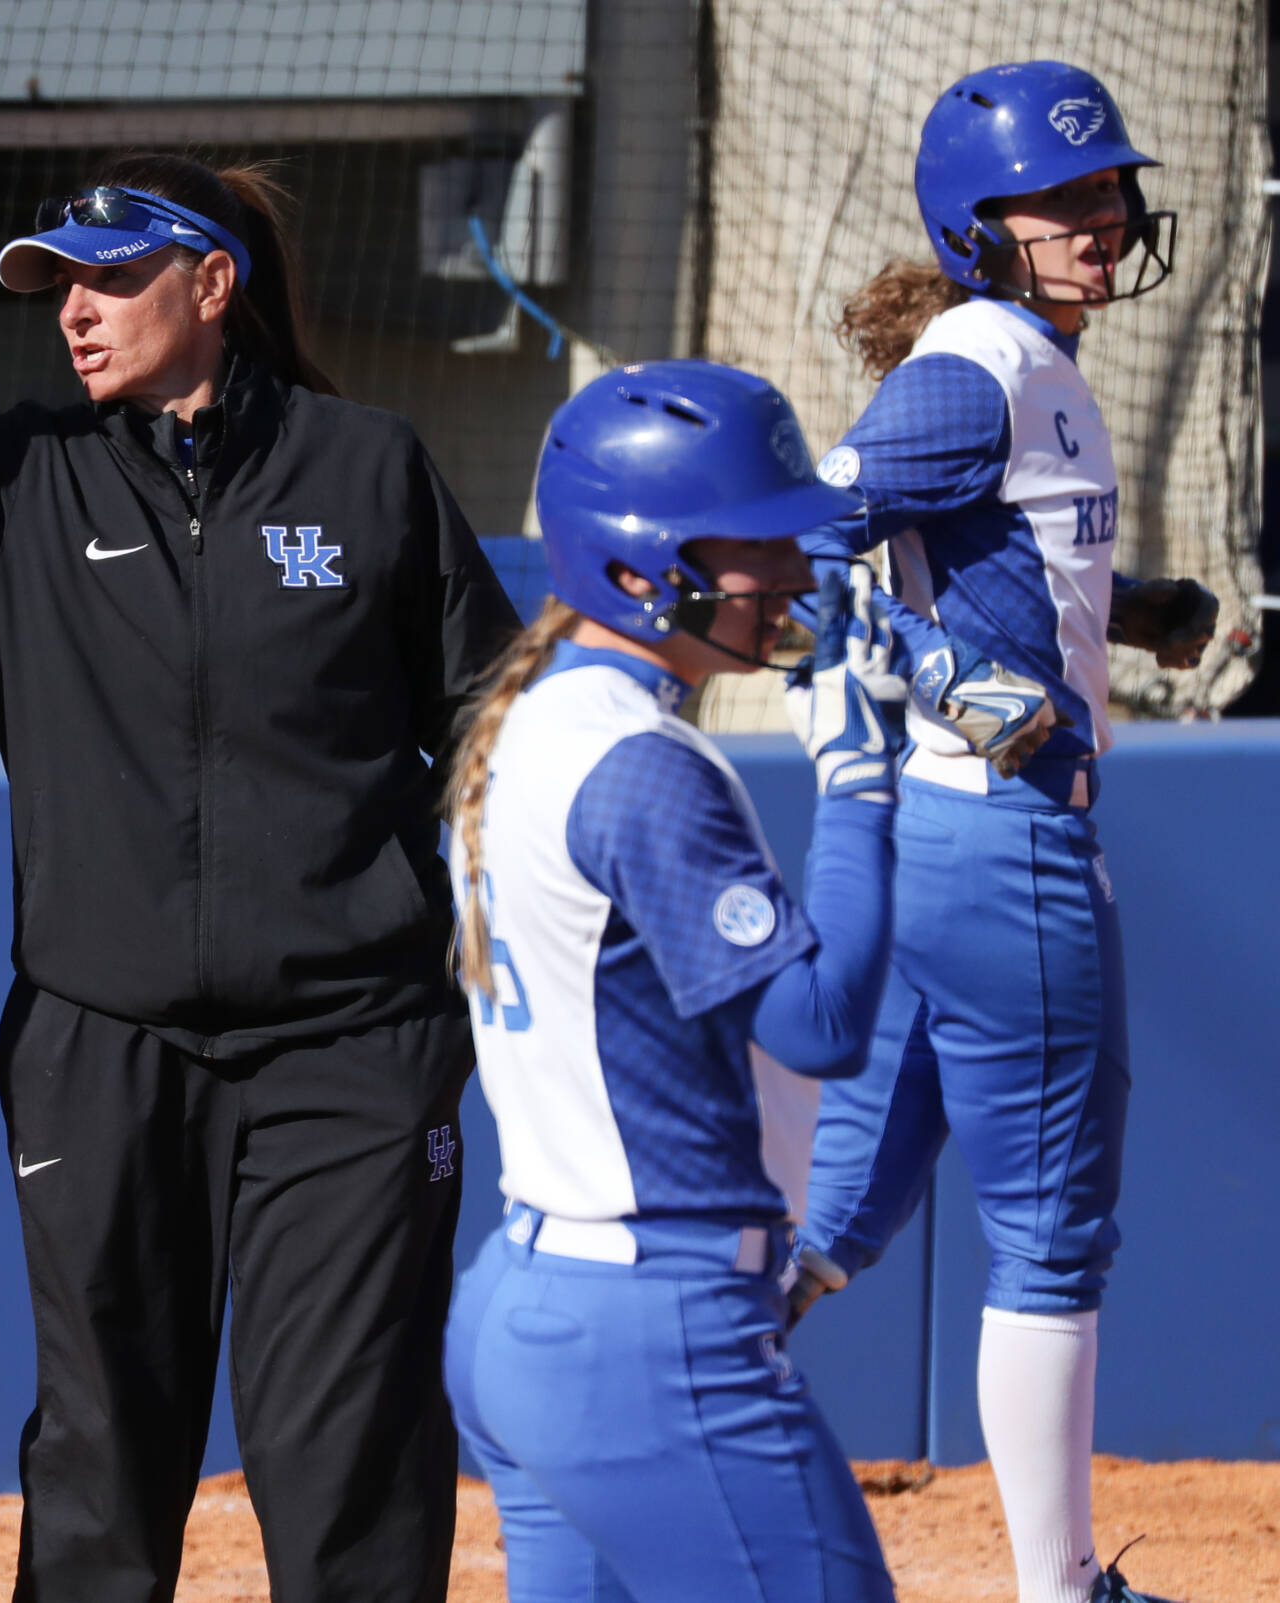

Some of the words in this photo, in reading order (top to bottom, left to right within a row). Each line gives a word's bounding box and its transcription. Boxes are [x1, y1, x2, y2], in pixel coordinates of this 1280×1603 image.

[96, 240, 150, 260] SOFTBALL
[1054, 411, 1080, 459] C
[261, 526, 345, 588] UK
[427, 1125, 456, 1181] UK
